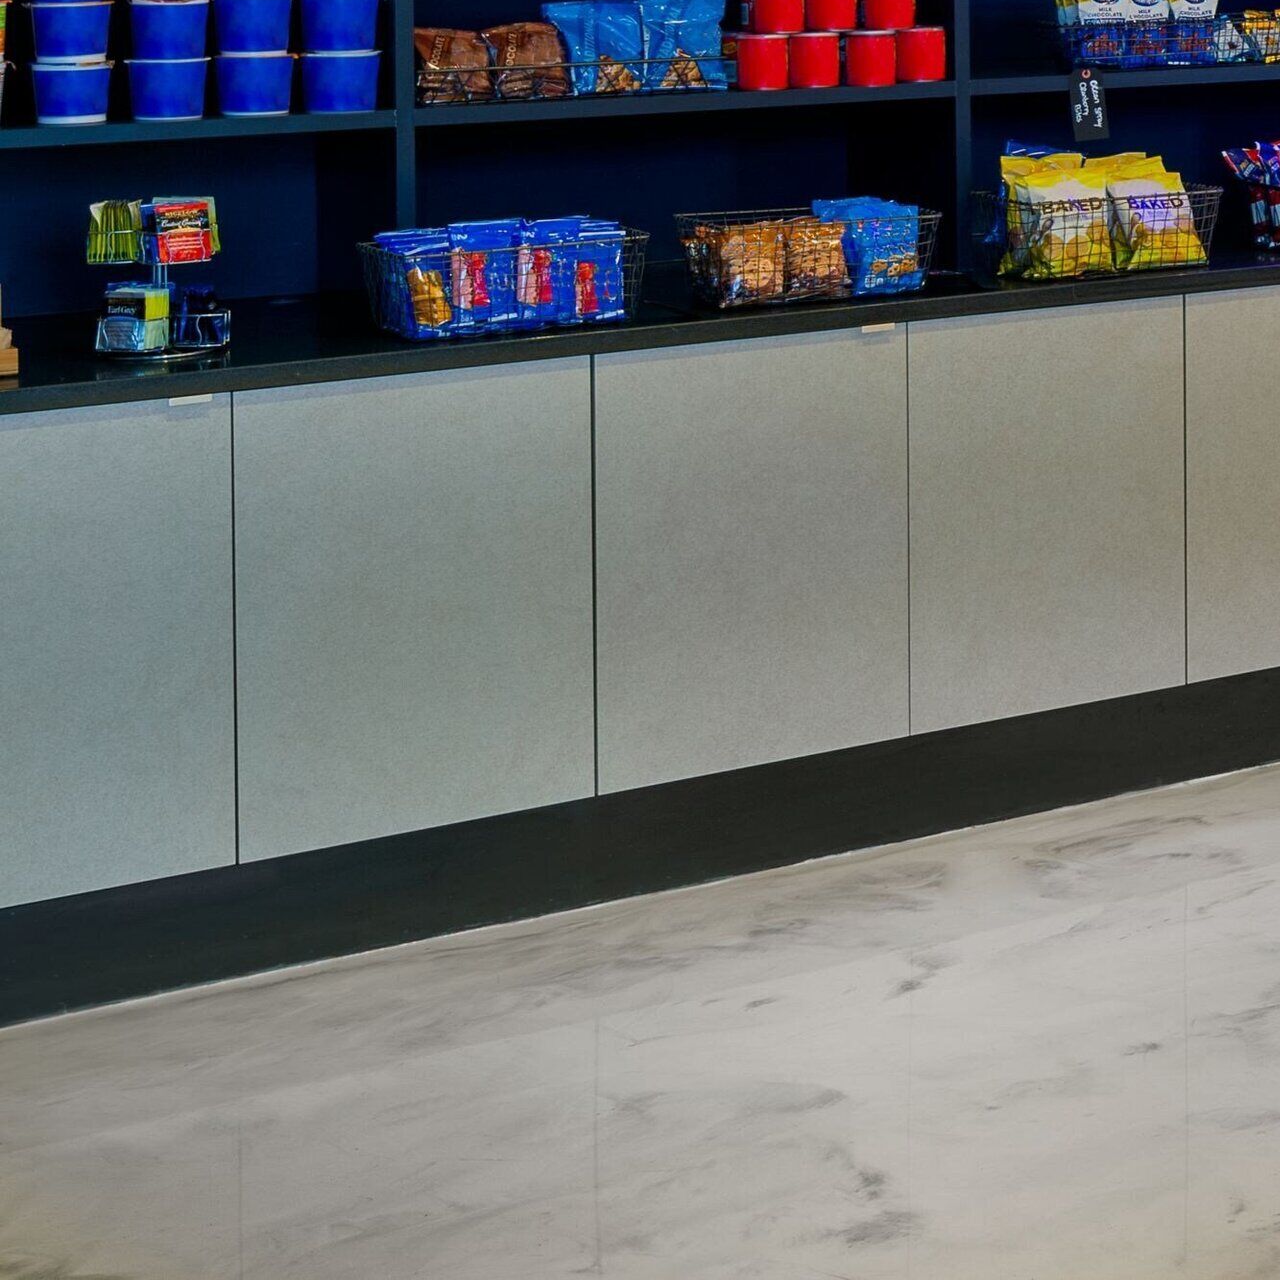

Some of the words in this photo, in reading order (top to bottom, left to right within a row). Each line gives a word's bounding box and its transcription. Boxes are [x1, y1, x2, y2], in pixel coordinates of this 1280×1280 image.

[1042, 197, 1102, 215] BAKED
[1127, 195, 1183, 210] BAKED
[108, 305, 120, 313] Earl
